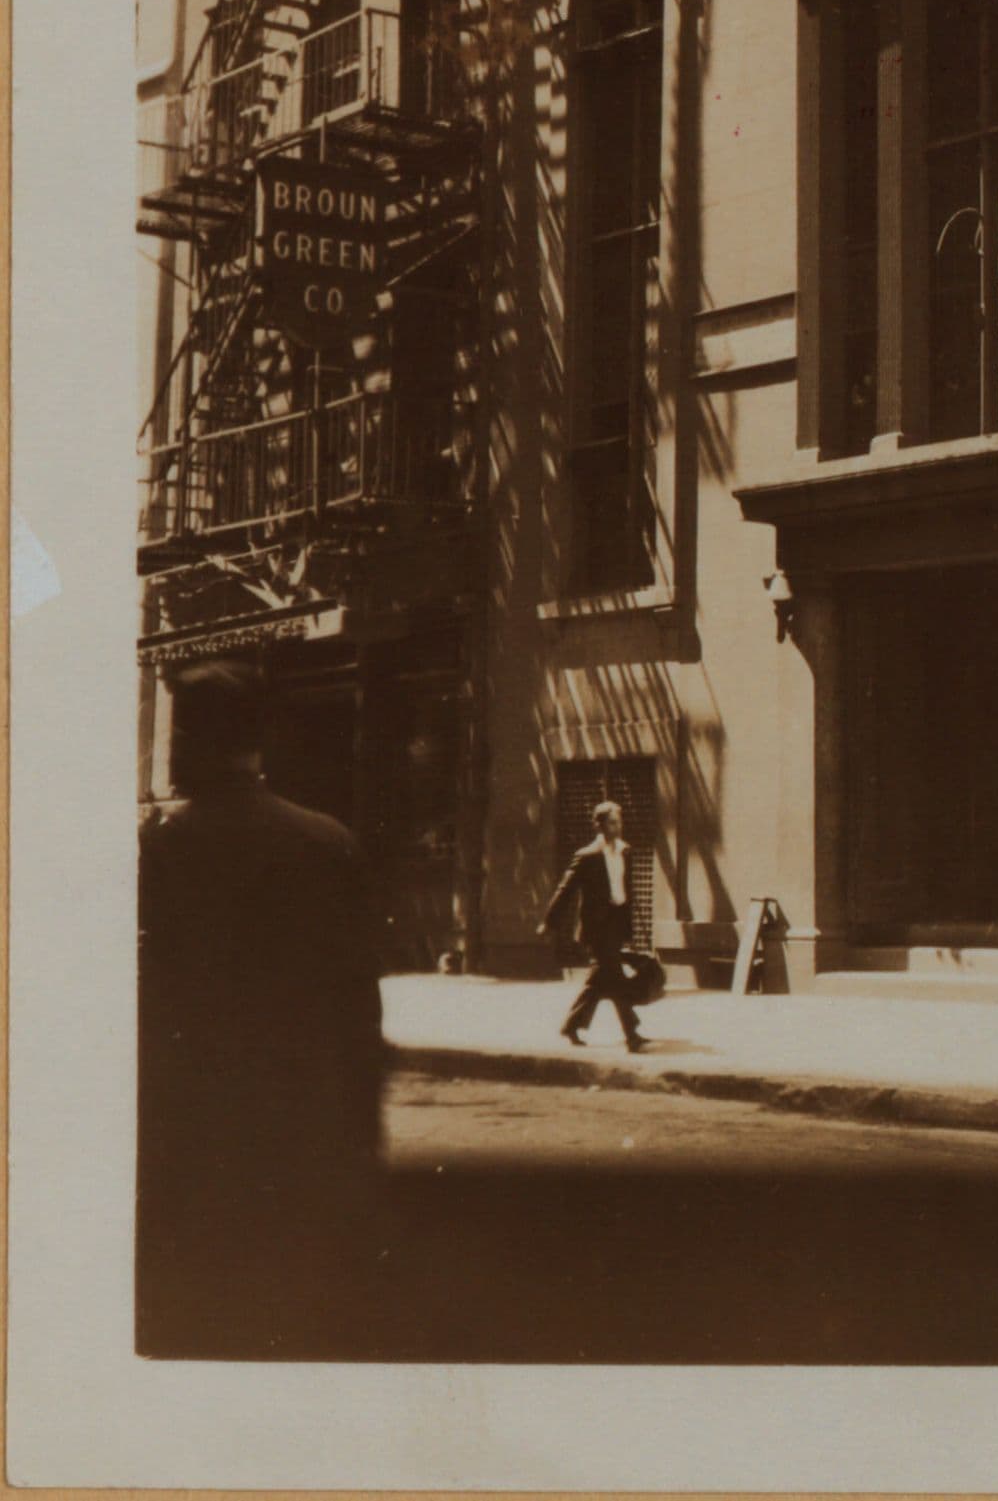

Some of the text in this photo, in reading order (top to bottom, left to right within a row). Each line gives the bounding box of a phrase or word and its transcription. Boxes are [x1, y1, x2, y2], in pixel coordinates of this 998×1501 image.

[273, 181, 376, 223] BROUN
[272, 230, 376, 273] GREEN
[303, 283, 344, 314] CO
